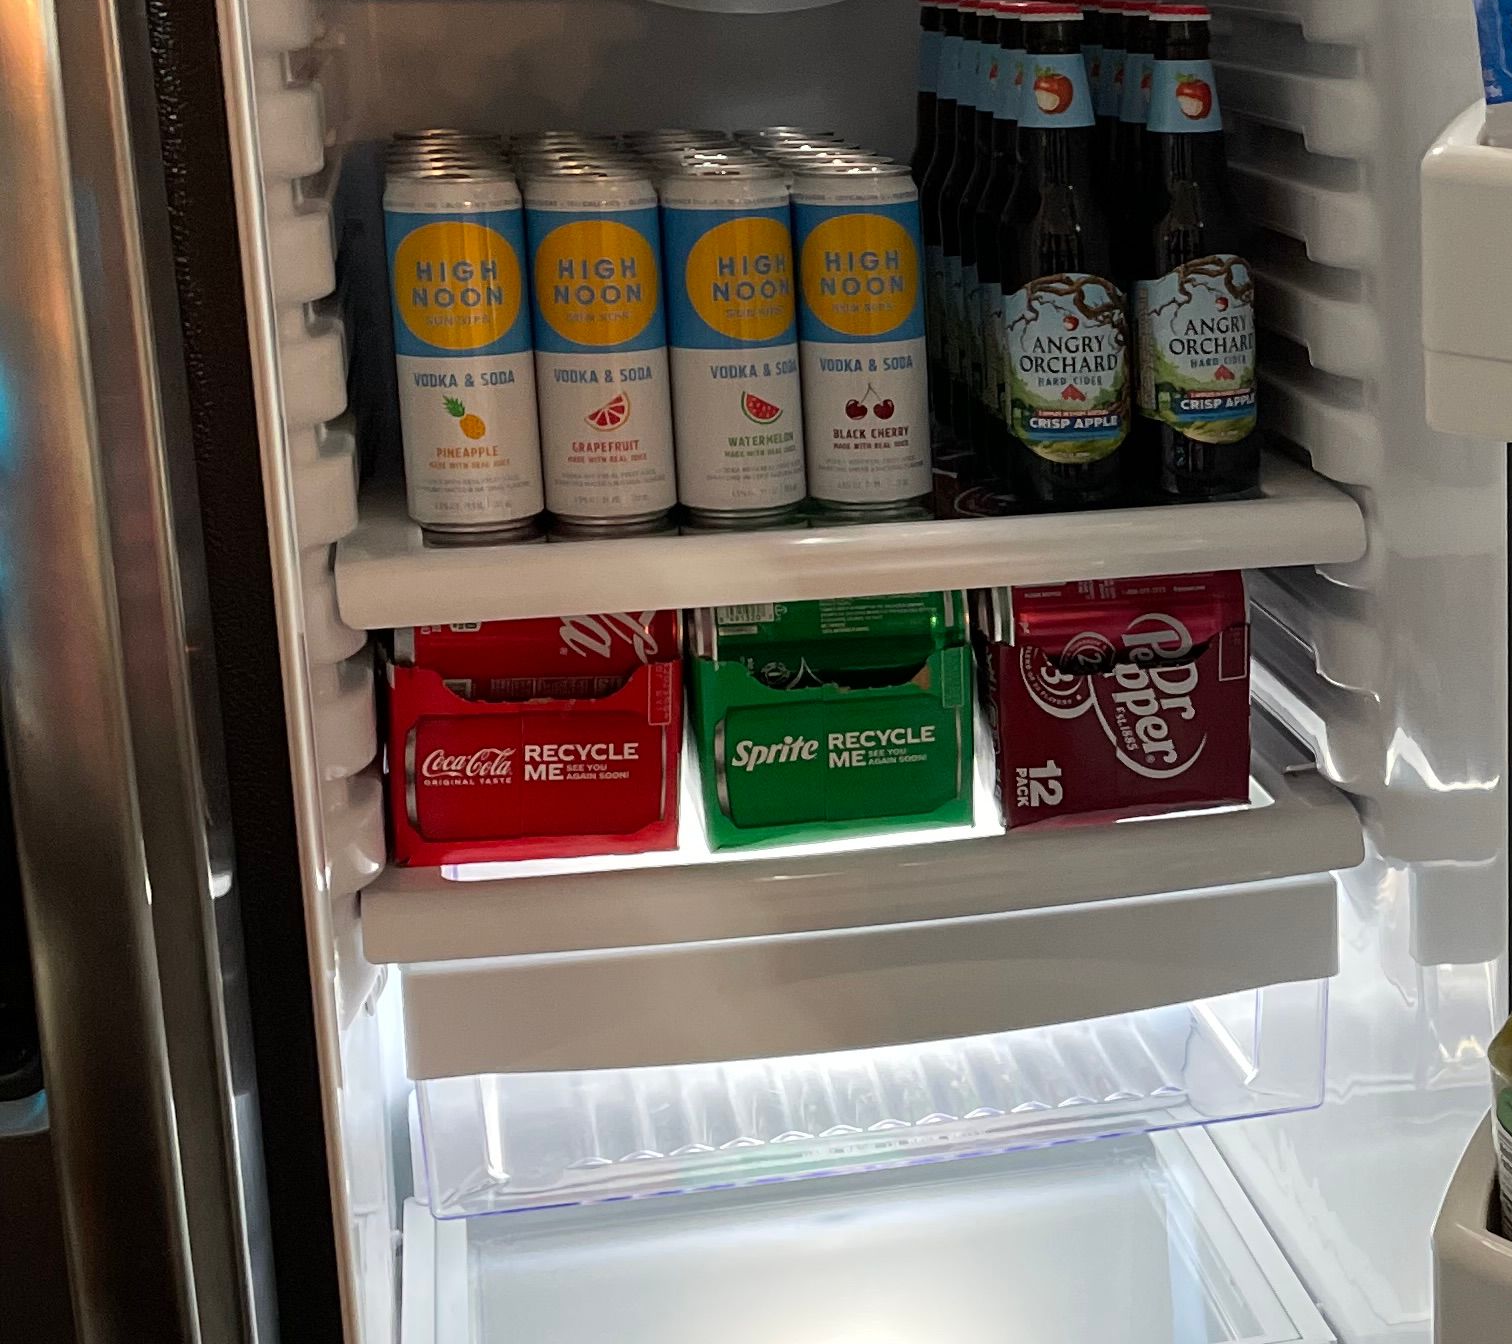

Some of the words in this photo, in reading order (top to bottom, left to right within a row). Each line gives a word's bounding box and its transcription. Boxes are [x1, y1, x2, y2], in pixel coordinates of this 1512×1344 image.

[415, 258, 497, 282] HIGH
[557, 256, 637, 280] HIGH
[717, 254, 786, 277] HIGH
[824, 250, 900, 273] HIGH
[553, 282, 642, 305] NOON
[712, 278, 789, 303] NOON
[820, 275, 905, 296] NOON
[411, 286, 505, 308] NOON
[1184, 313, 1247, 336] ANGRY
[1032, 335, 1105, 354] ANGRY
[710, 365, 757, 379] VODKA
[763, 363, 772, 377] &
[776, 359, 798, 376] SODA
[819, 357, 862, 372] VODKA
[868, 358, 878, 371] &
[883, 355, 914, 370] SODA
[1020, 354, 1118, 374] ORCHARD
[413, 372, 459, 388] VODKA
[465, 374, 475, 387] &
[481, 369, 515, 386] SODA
[554, 368, 599, 384] VODKA
[604, 369, 614, 383] &
[620, 366, 653, 382] SODA
[1038, 376, 1067, 387] HARD
[1073, 375, 1103, 386] CIDER
[1180, 398, 1222, 411] CRISP
[1029, 417, 1070, 429] CRISP
[1074, 415, 1118, 429] APPLE
[728, 431, 794, 448] WATERMELON
[832, 427, 867, 440] BLACK
[871, 426, 909, 439] CHERRY
[436, 445, 499, 459] PINEAPPLE
[572, 439, 641, 454] GRAPEFRUIT
[1150, 662, 1199, 720] Dr
[828, 725, 936, 750] RECYCLE
[524, 742, 639, 762] RECYCLE
[731, 735, 820, 772] Sprite
[828, 750, 867, 769] ME
[868, 749, 886, 757] SEE
[887, 748, 907, 756] YOU
[868, 757, 897, 765] AGAIN
[422, 747, 517, 778] Coca-Cola
[524, 763, 564, 782] ME
[566, 764, 588, 772] SEE
[590, 763, 608, 772] YOU
[423, 779, 475, 787] ORIGINAL
[479, 777, 512, 785] TASTE
[1015, 767, 1029, 807] PACK
[1029, 759, 1063, 807] 12
